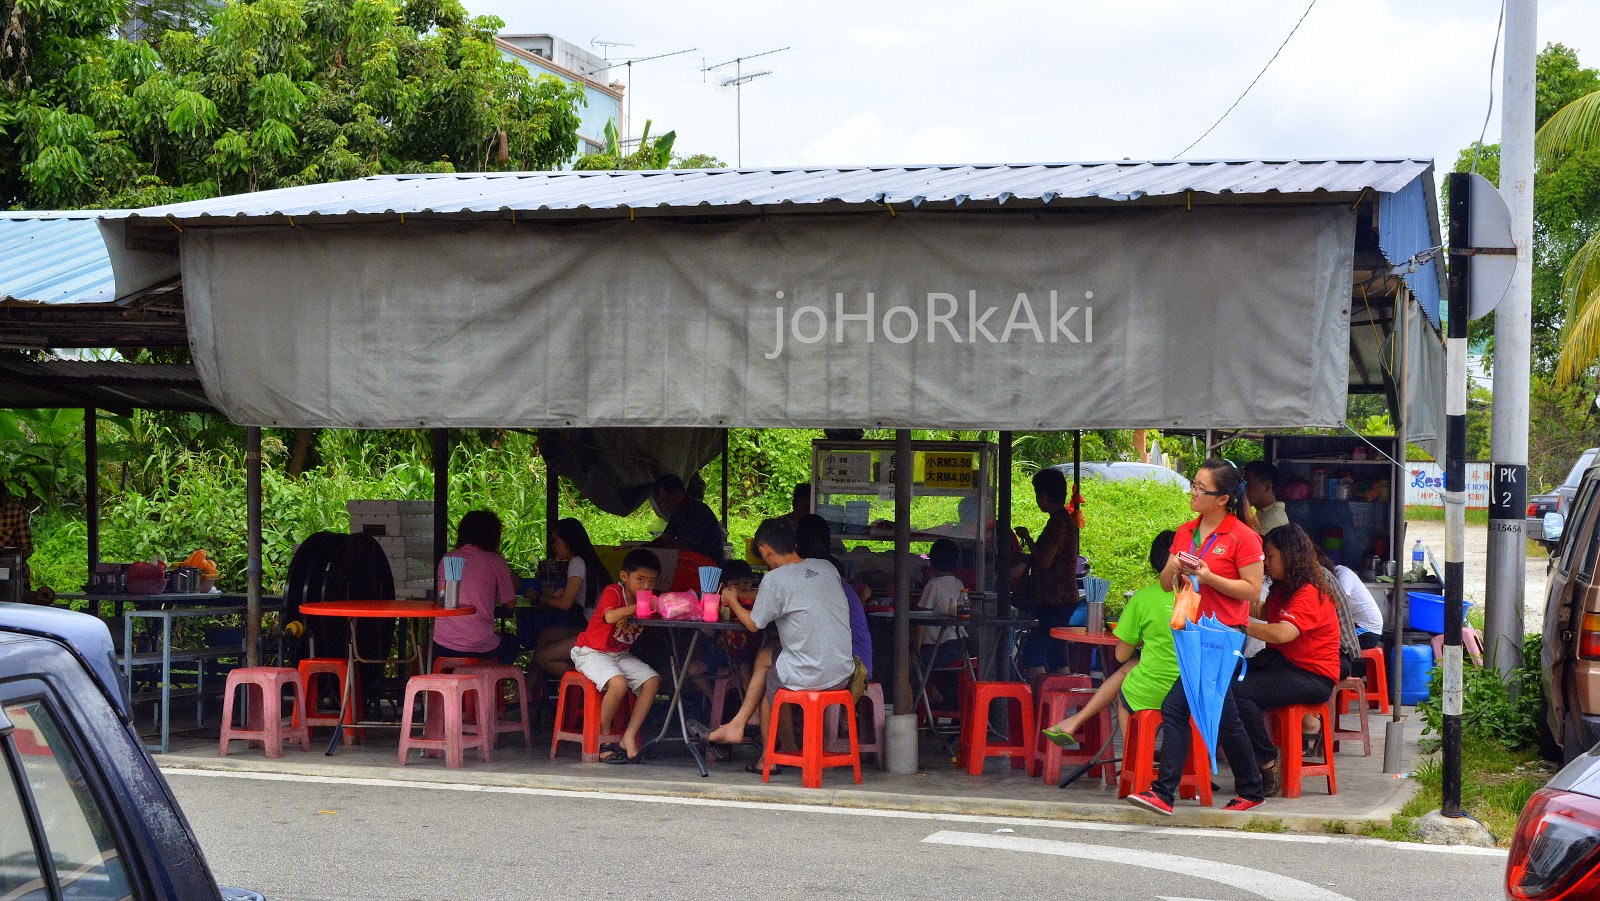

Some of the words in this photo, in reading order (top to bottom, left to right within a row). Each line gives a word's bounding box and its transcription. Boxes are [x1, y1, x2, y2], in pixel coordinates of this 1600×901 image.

[826, 454, 836, 464] 小
[926, 457, 936, 468] 小
[937, 457, 971, 468] RM3.50
[825, 466, 836, 476] 大
[1500, 468, 1517, 483] PK
[926, 471, 936, 481] 大
[936, 472, 971, 483] RM4.00
[1502, 491, 1512, 508] 2
